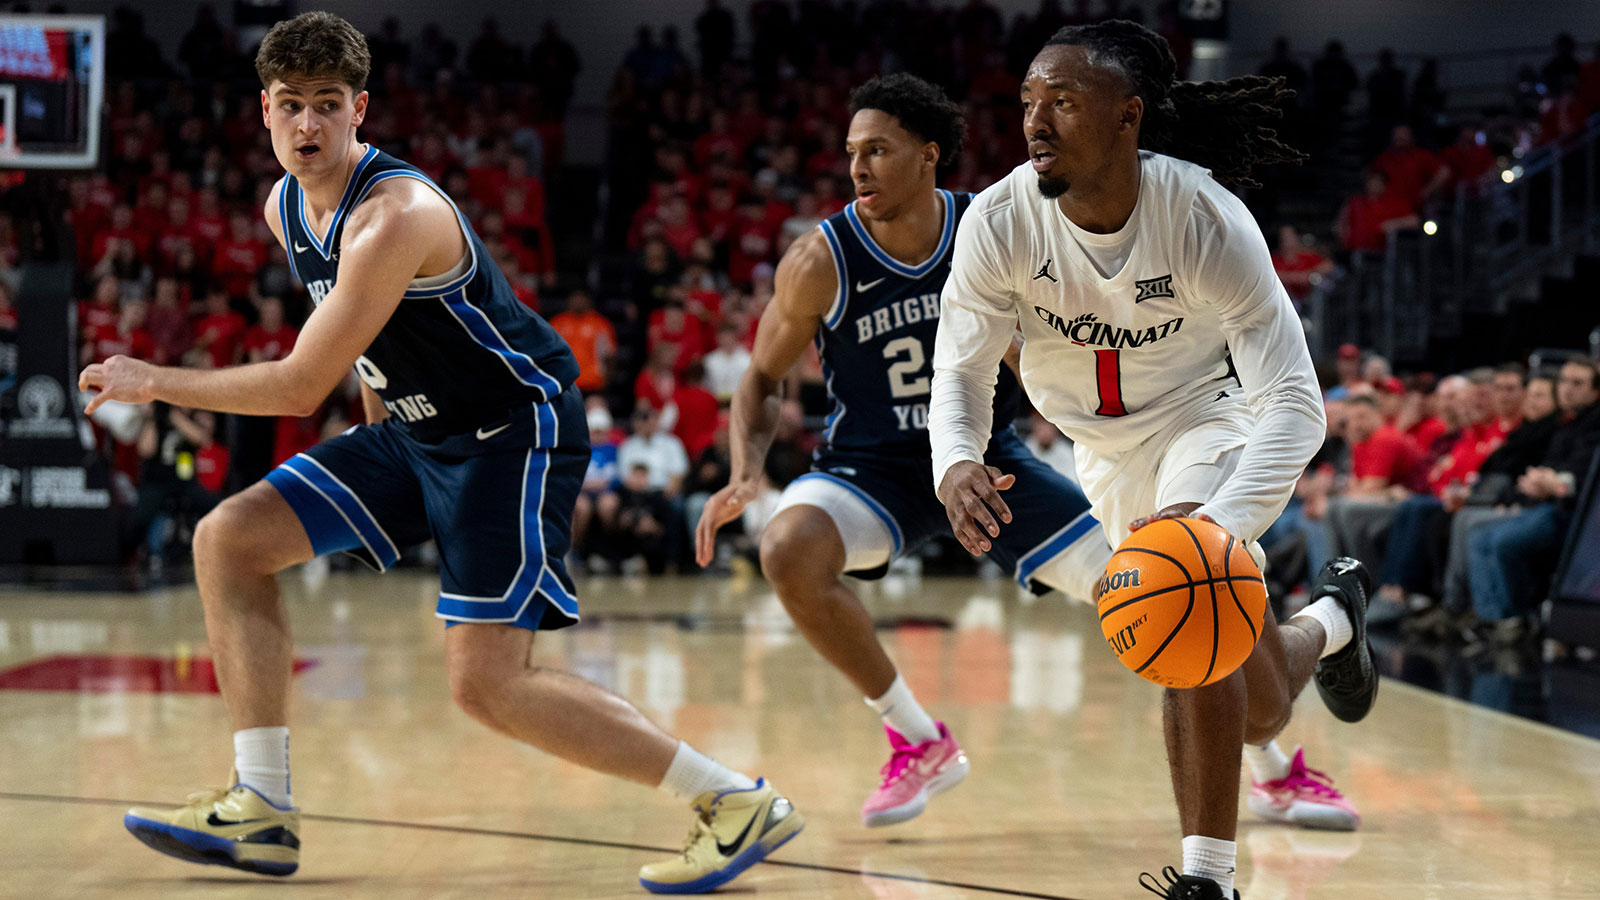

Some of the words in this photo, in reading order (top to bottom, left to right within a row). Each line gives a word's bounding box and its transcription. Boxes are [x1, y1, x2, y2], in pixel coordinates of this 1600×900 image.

[1135, 274, 1175, 303] XII
[855, 293, 941, 344] BRIGH
[1034, 305, 1184, 349] CINCINNATI
[882, 336, 935, 398] 2
[1094, 349, 1130, 417] 1
[892, 403, 930, 431] YO
[1097, 567, 1141, 601] lson
[1132, 612, 1148, 630] NXT
